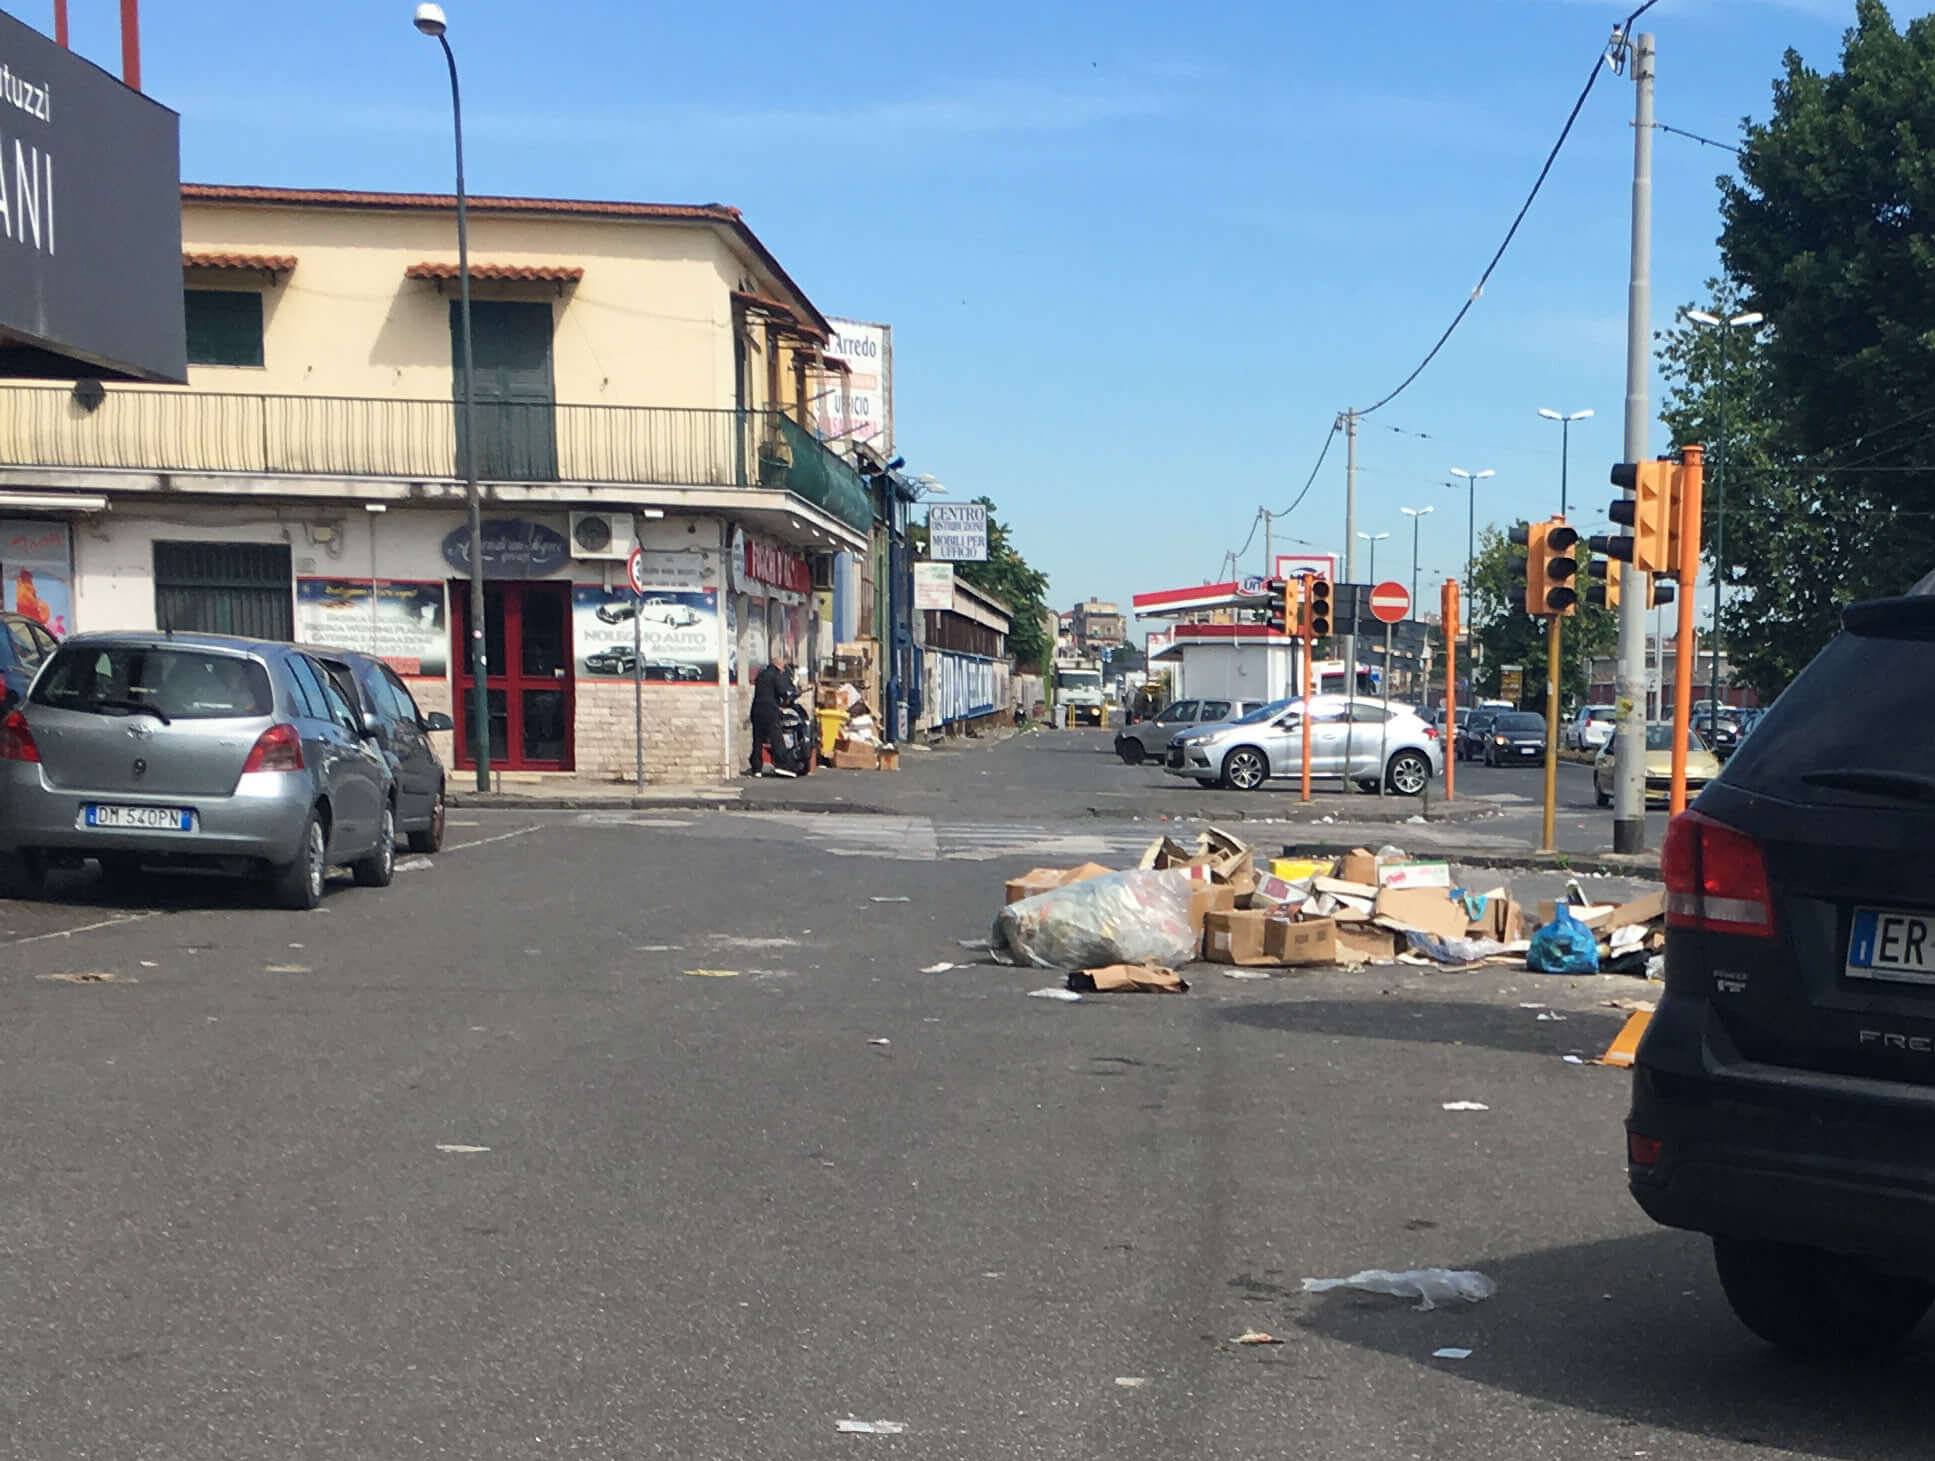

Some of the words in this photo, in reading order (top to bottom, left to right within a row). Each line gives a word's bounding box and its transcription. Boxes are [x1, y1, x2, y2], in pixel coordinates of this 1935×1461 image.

[835, 333, 877, 358] Arredo
[834, 394, 869, 417] UICIO
[931, 507, 985, 521] CENTRO
[932, 535, 965, 546] MOBILI
[967, 535, 985, 547] PER
[940, 544, 977, 558] UFFICIO
[664, 632, 706, 645] AUTO
[99, 806, 119, 824] DM
[1879, 917, 1928, 966] ER
[1859, 1029, 1935, 1052] FRE
